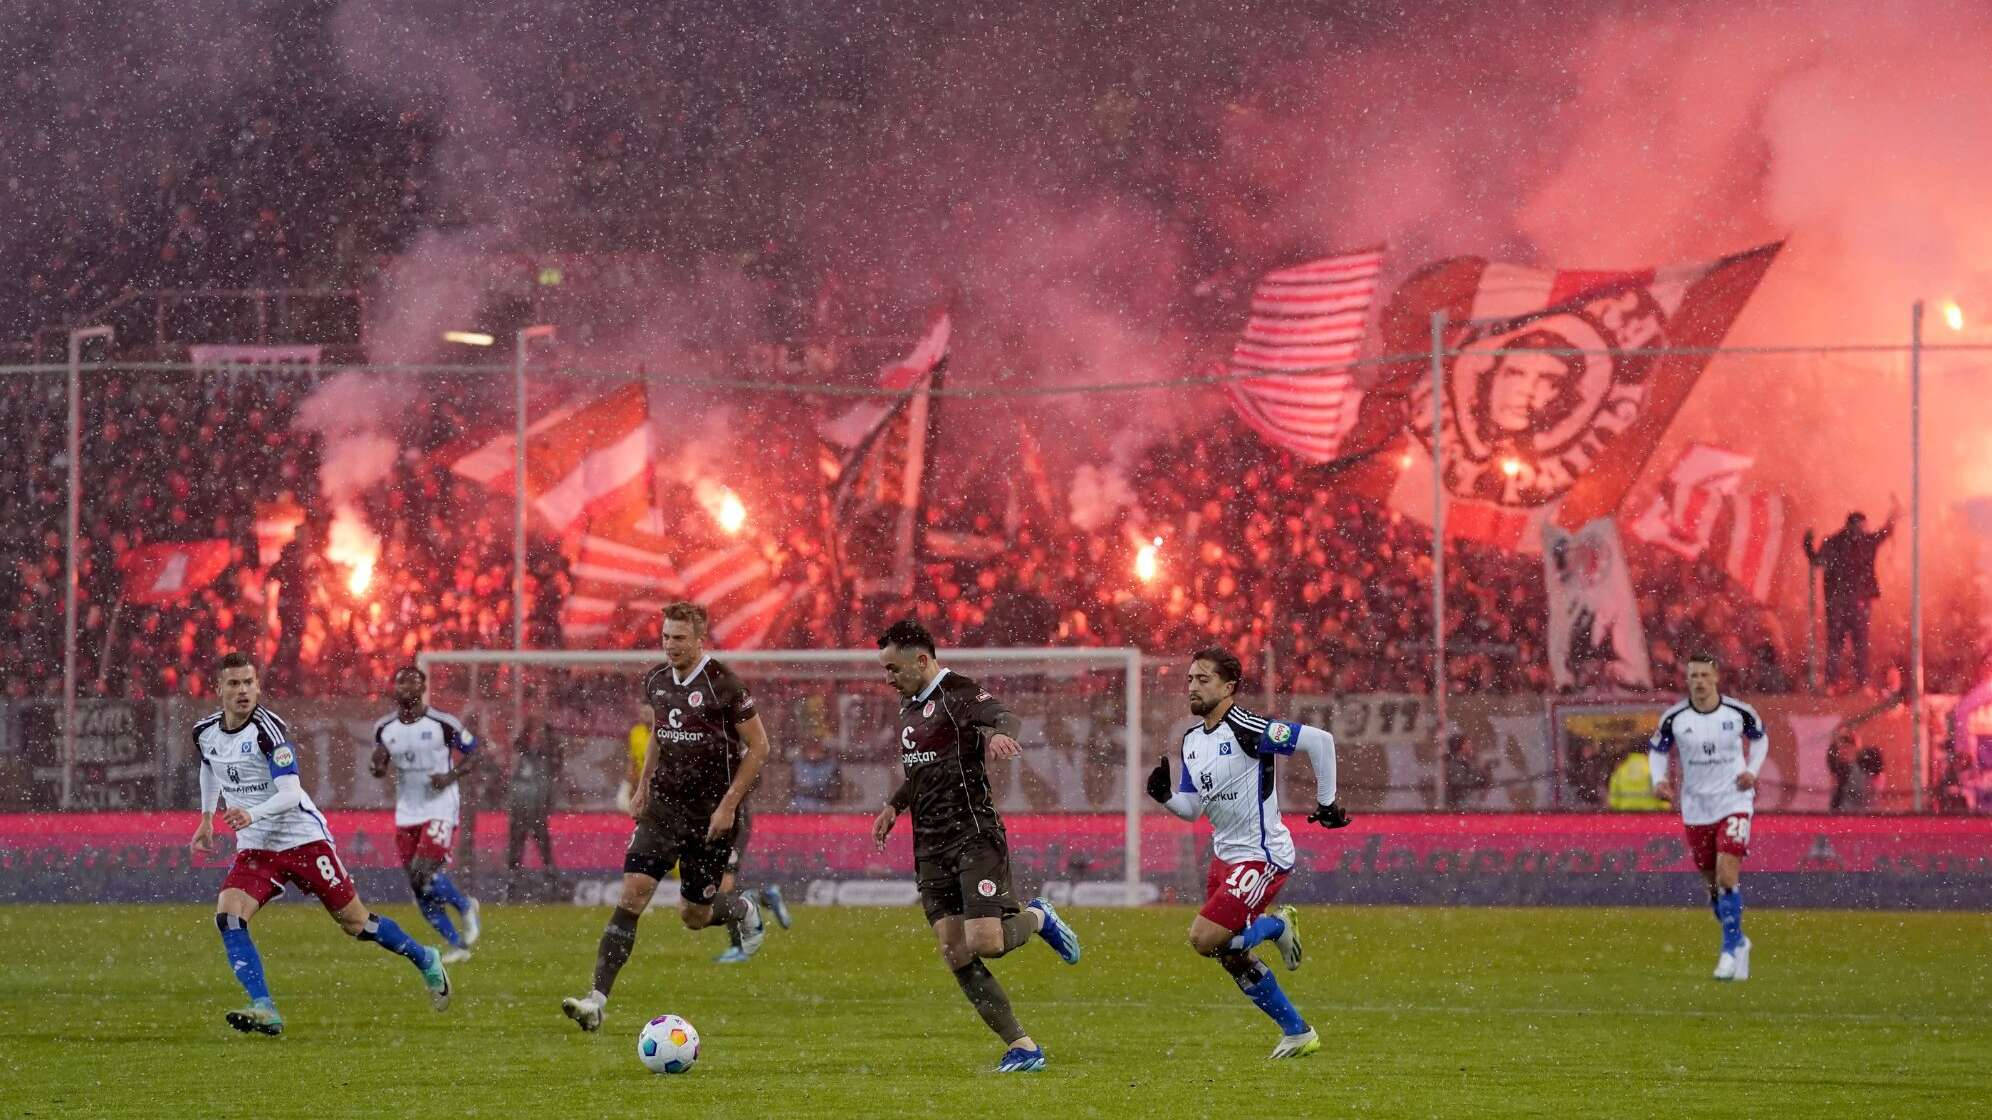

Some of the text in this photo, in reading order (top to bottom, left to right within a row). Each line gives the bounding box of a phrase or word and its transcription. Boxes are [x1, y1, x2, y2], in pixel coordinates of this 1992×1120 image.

[657, 728, 703, 743] congstar
[316, 855, 336, 881] 8
[1226, 864, 1260, 893] 10
